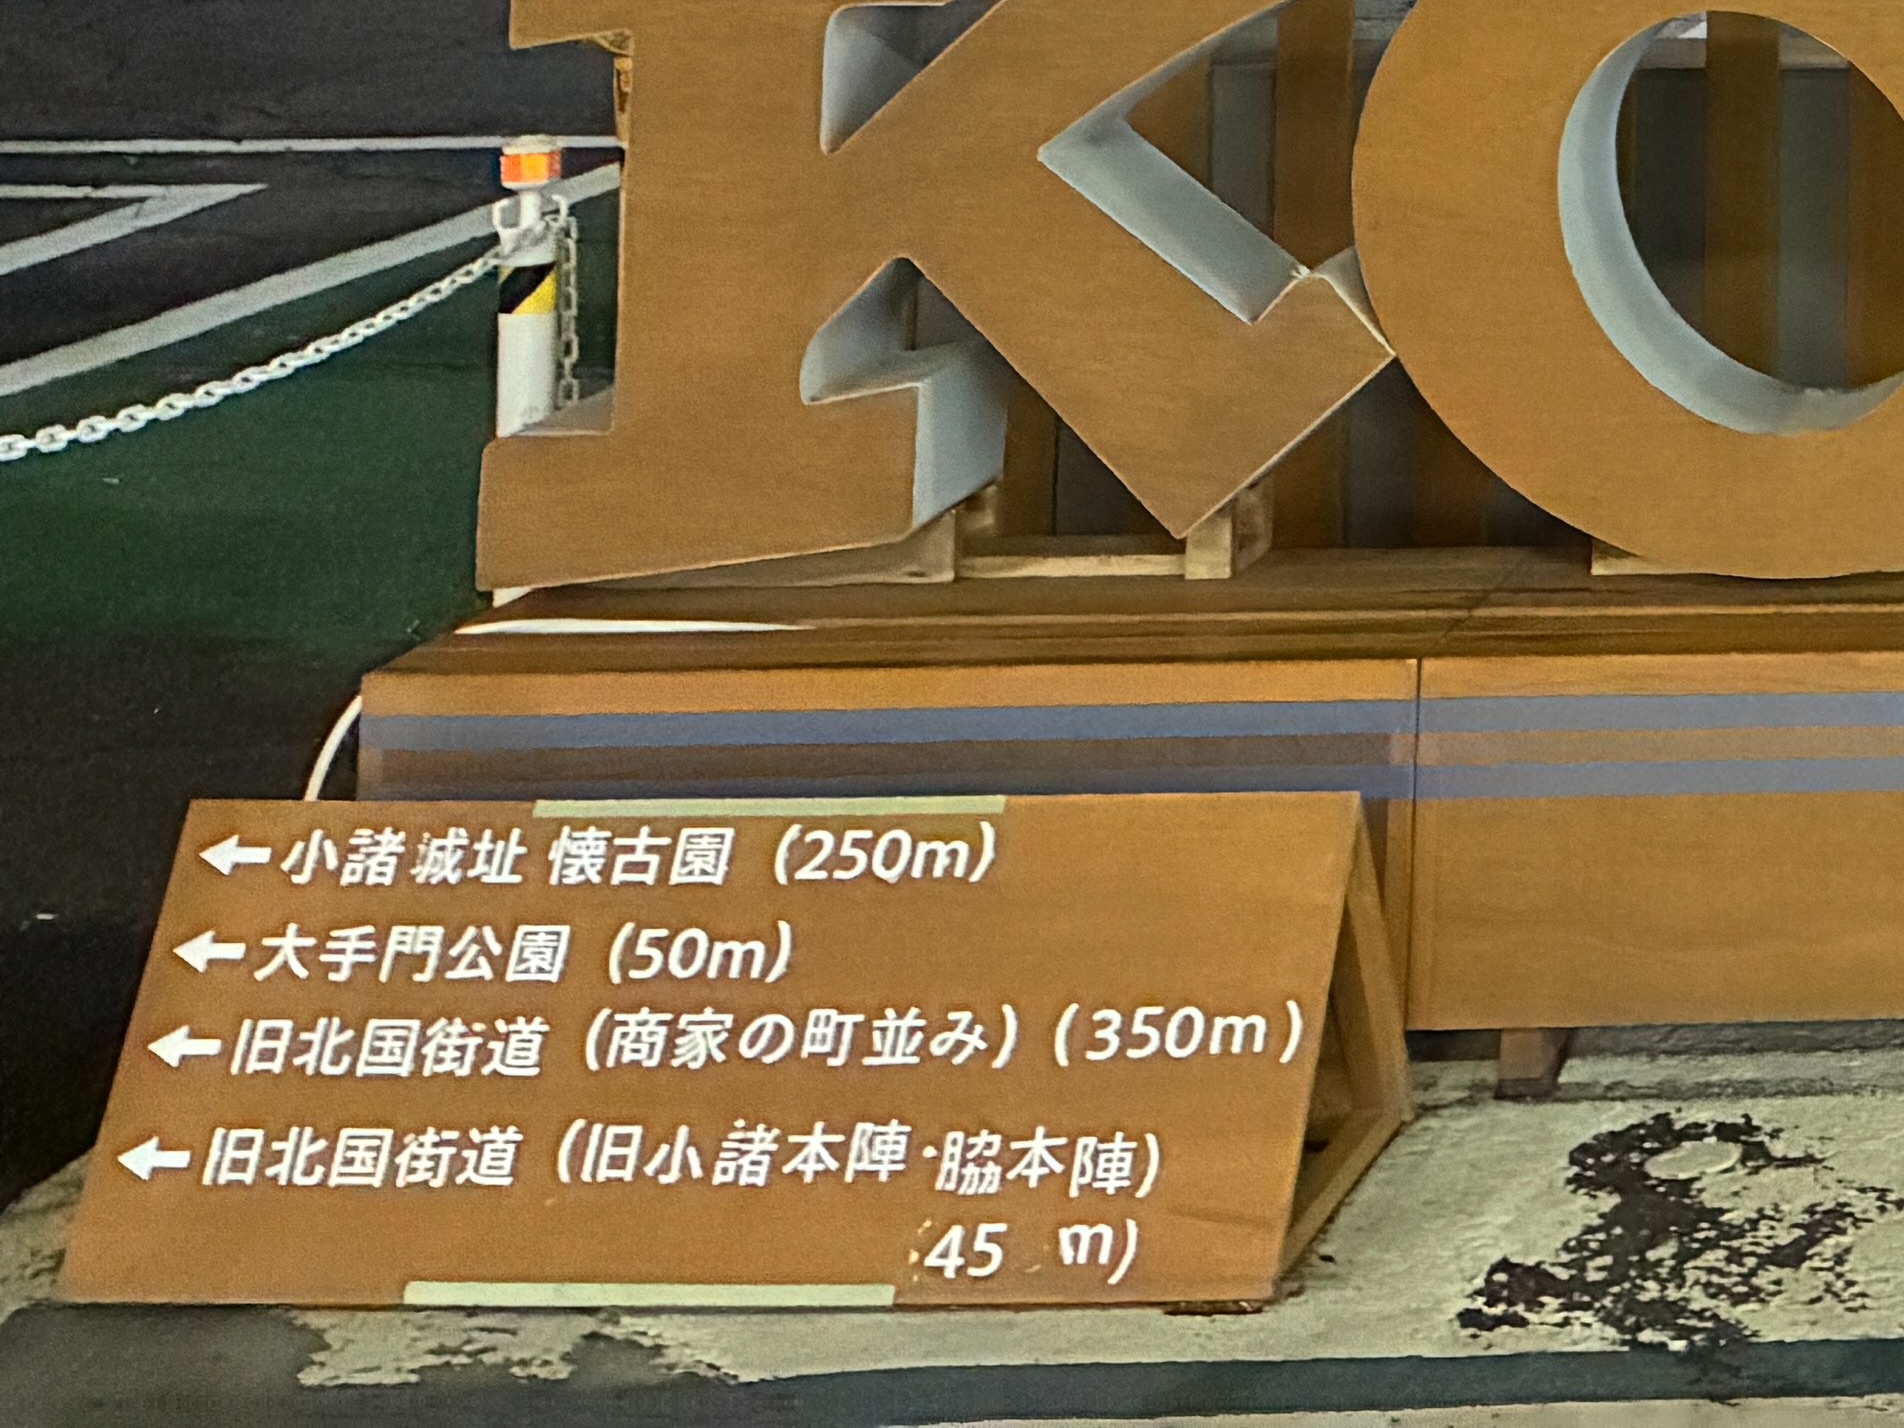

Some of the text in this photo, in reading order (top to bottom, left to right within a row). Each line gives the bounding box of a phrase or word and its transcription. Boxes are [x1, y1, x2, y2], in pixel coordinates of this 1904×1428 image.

[279, 820, 997, 888] 小諸城址 懐古園 (250m)
[253, 920, 793, 985] 大手門公園 (50m)
[230, 1017, 550, 1077] 旧北国街道
[1052, 998, 1304, 1067] (350m)
[201, 1124, 526, 1188] 旧北国街道
